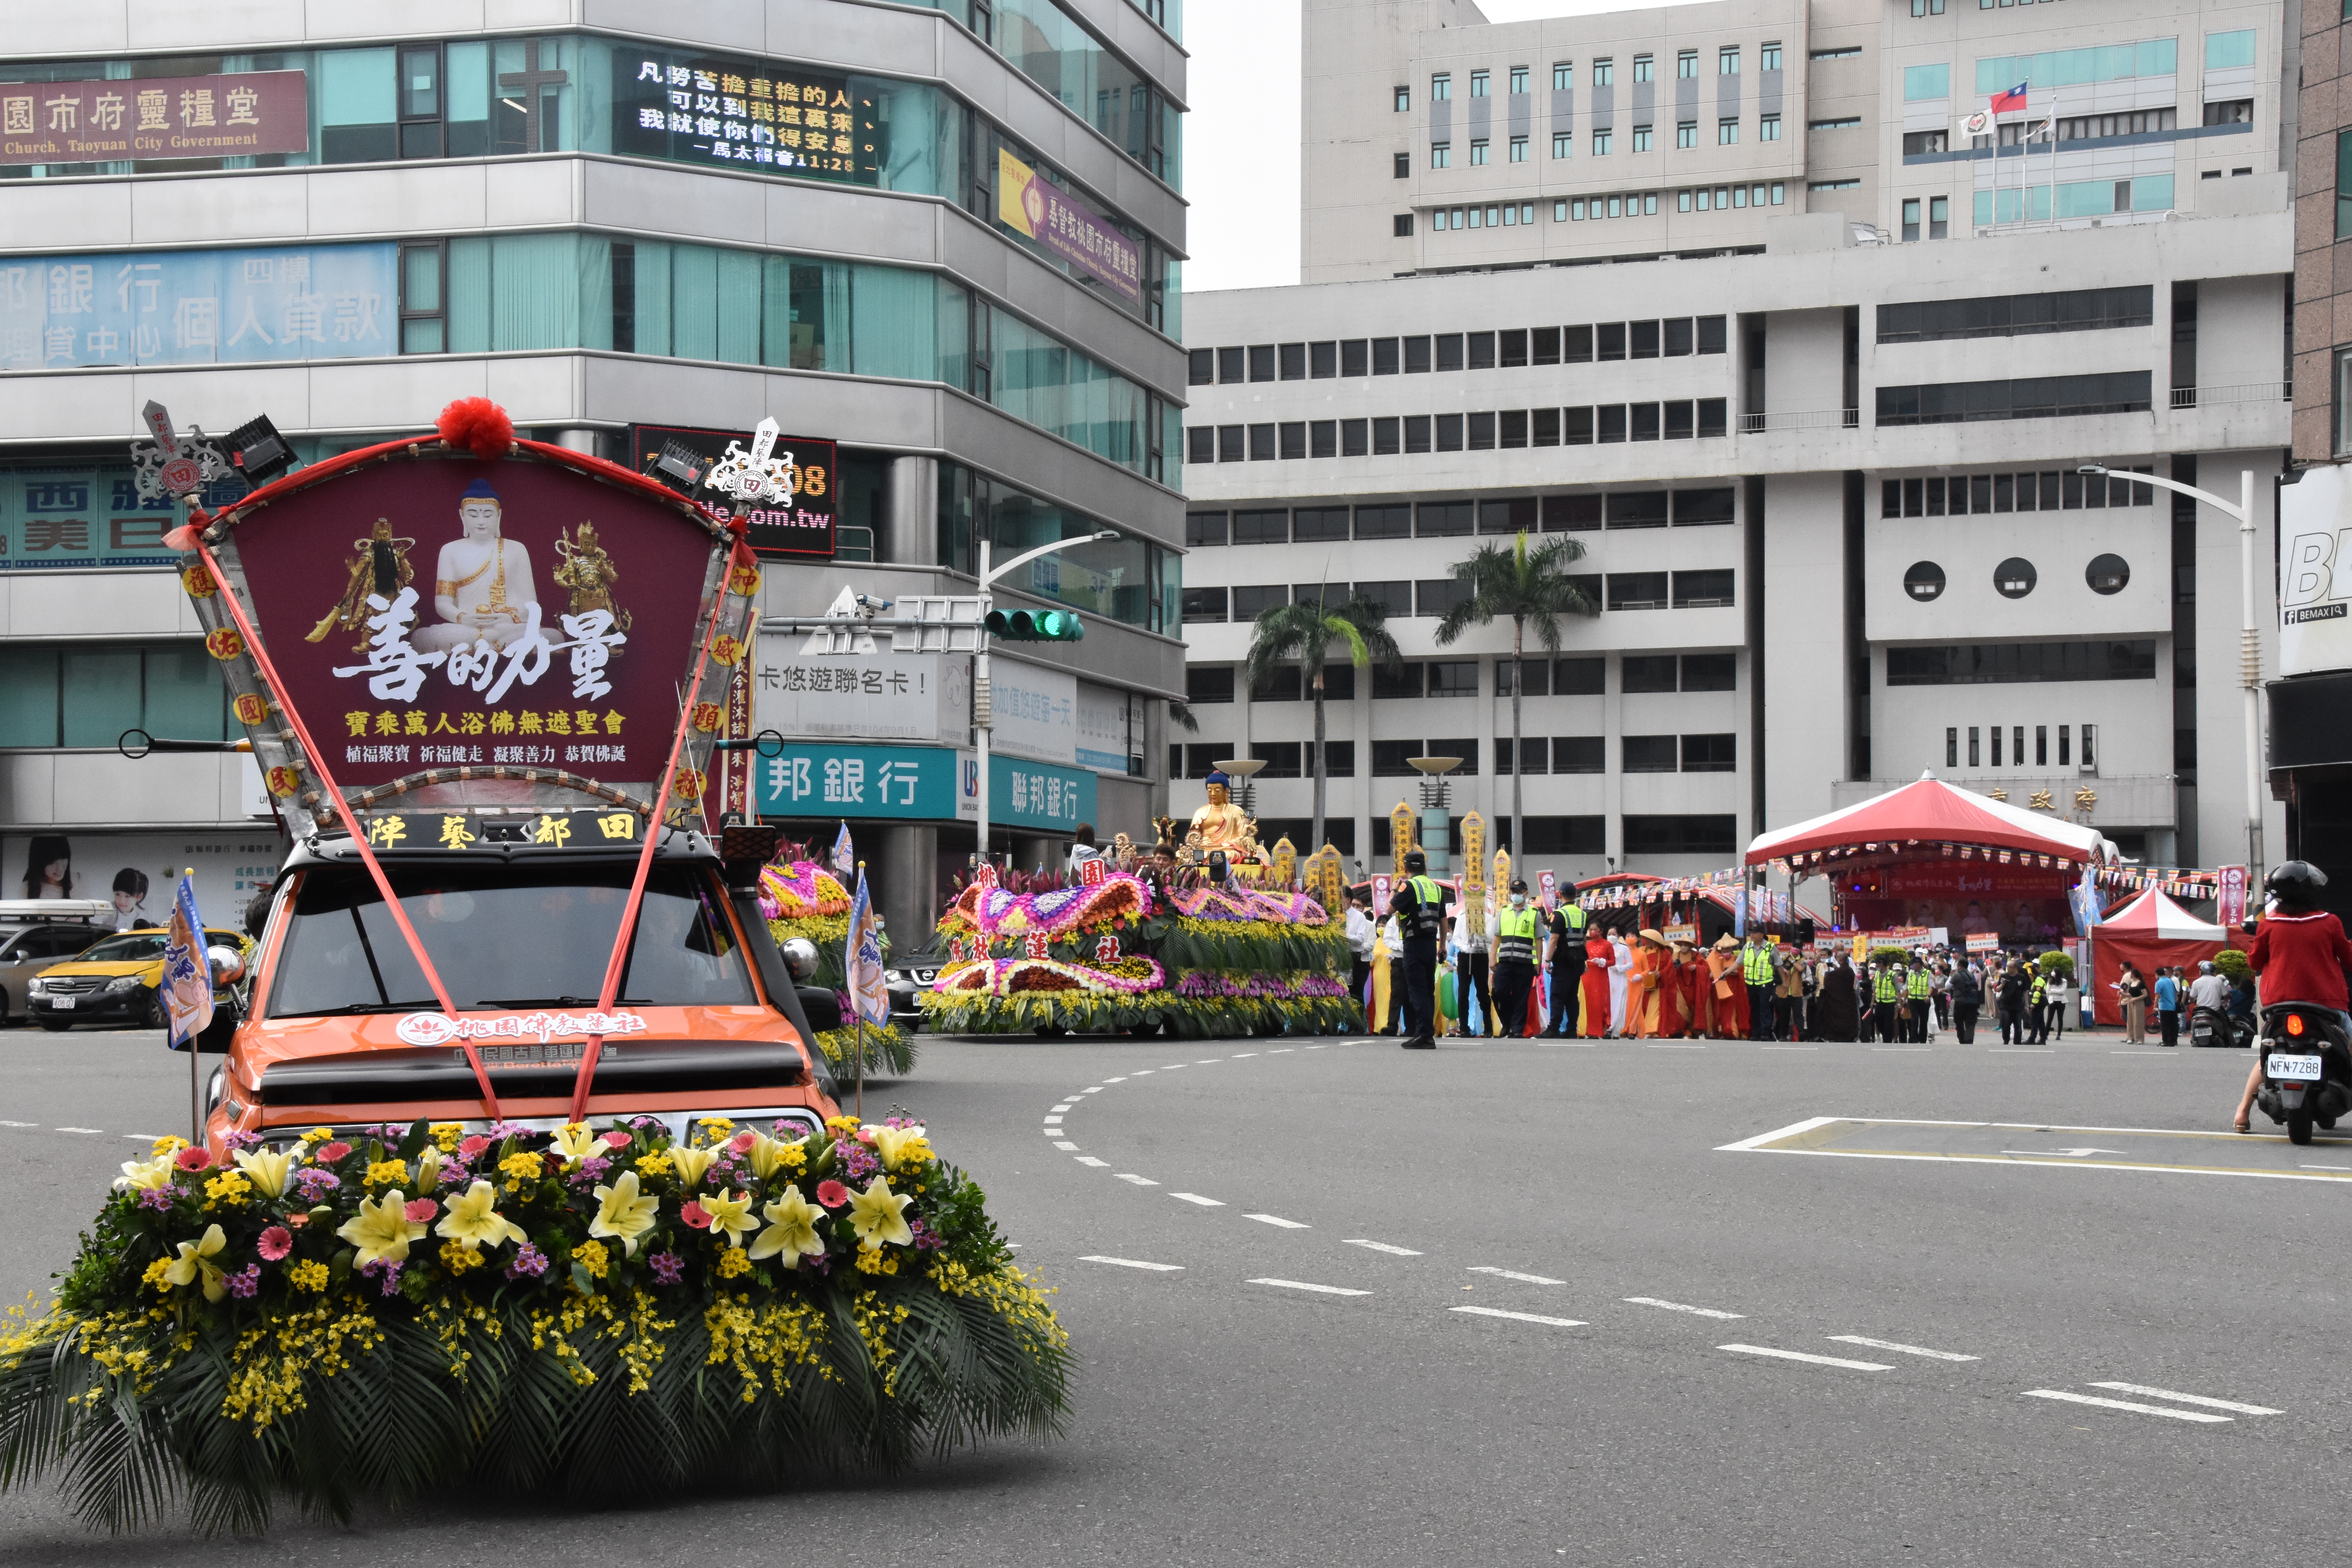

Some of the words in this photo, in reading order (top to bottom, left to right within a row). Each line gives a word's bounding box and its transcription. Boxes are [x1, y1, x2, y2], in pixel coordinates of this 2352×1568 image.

[3, 87, 260, 134] 園市府靈糧堂
[5, 141, 60, 154] Church,
[68, 139, 127, 154] Taoyuan
[135, 136, 163, 151] City
[171, 133, 258, 148] Government
[244, 256, 310, 285] 四樓
[173, 292, 382, 348] 個人貸款
[752, 430, 772, 467] 田都藝陣
[745, 478, 760, 492] 田
[2299, 607, 2329, 620] BEMAX
[333, 587, 627, 704] 善的力量
[758, 665, 924, 695] 卡悠遊聯名卡！
[345, 709, 627, 737] 寶乘萬人浴佛無遮聖會
[346, 744, 409, 763] 植福聚寶
[420, 745, 483, 762] 祈福健走
[494, 745, 555, 763] 凝聚善力
[565, 745, 626, 762] 恭賀佛誕
[1012, 771, 1077, 820] 聯邦銀行
[456, 1014, 645, 1041] 桃園佛教蓮社
[504, 1062, 561, 1070] Beretta
